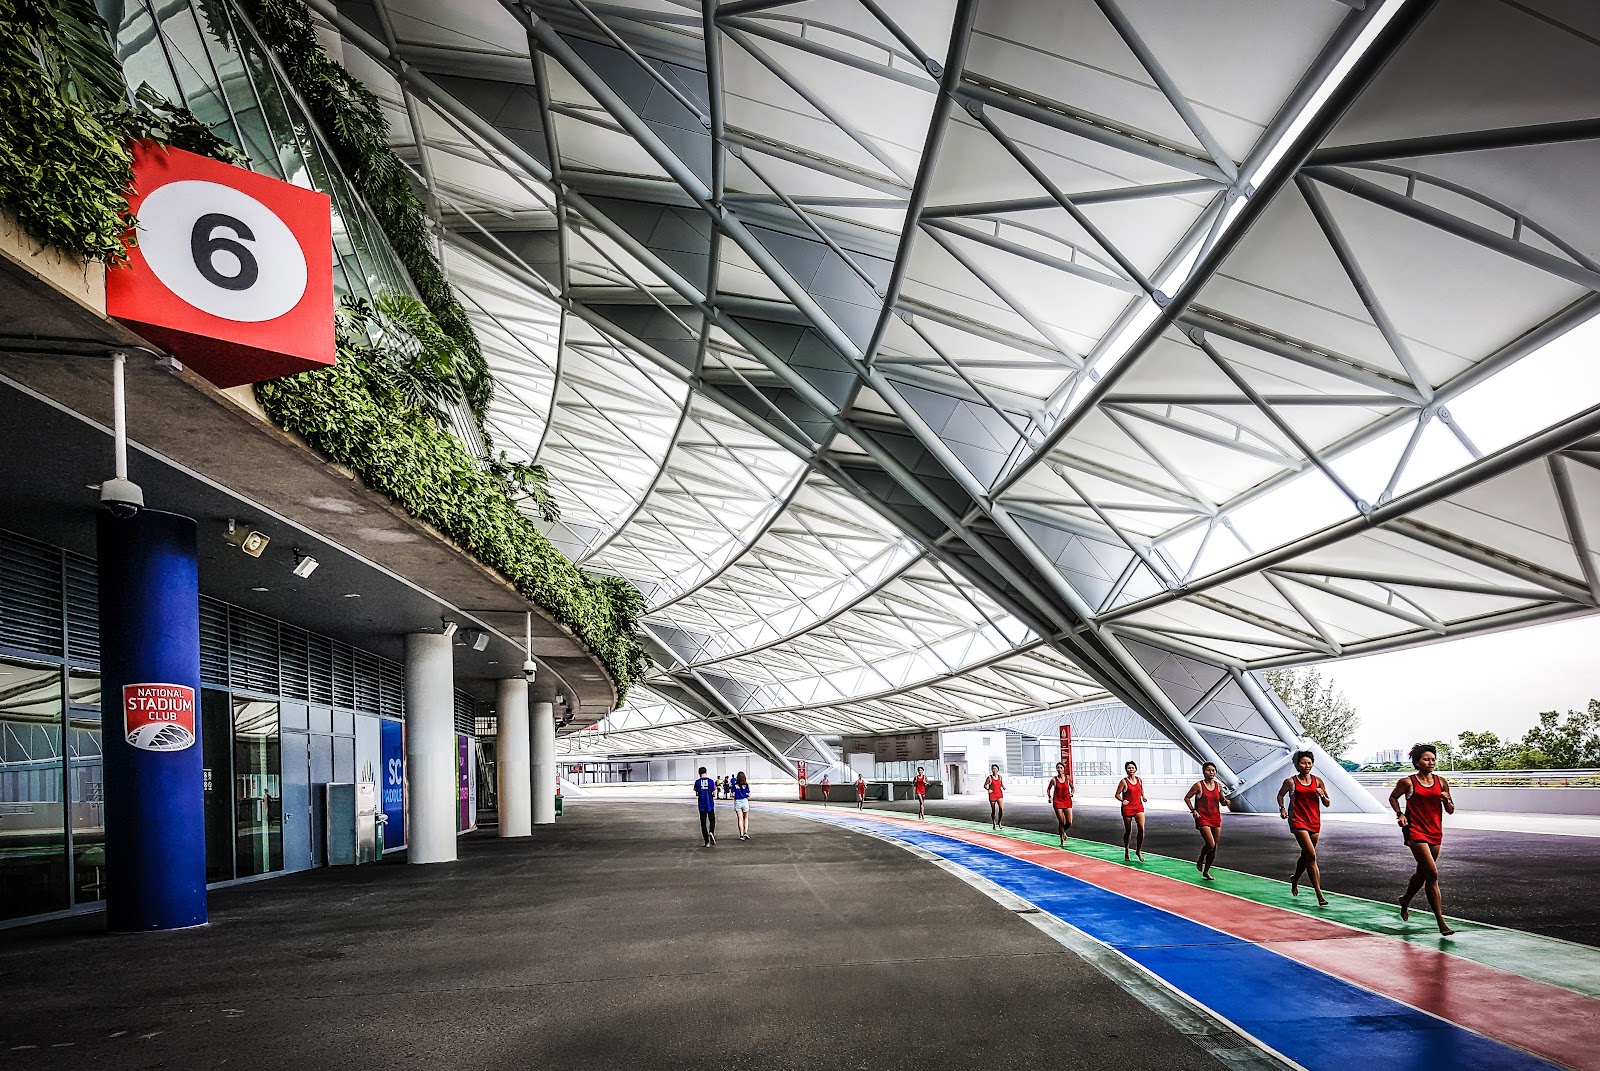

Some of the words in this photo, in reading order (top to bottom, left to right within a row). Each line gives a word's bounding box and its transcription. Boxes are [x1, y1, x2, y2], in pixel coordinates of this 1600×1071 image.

[190, 212, 259, 291] 6
[138, 688, 184, 698] NATIONAL
[128, 697, 192, 712] STADIUM
[148, 711, 177, 721] CLUB
